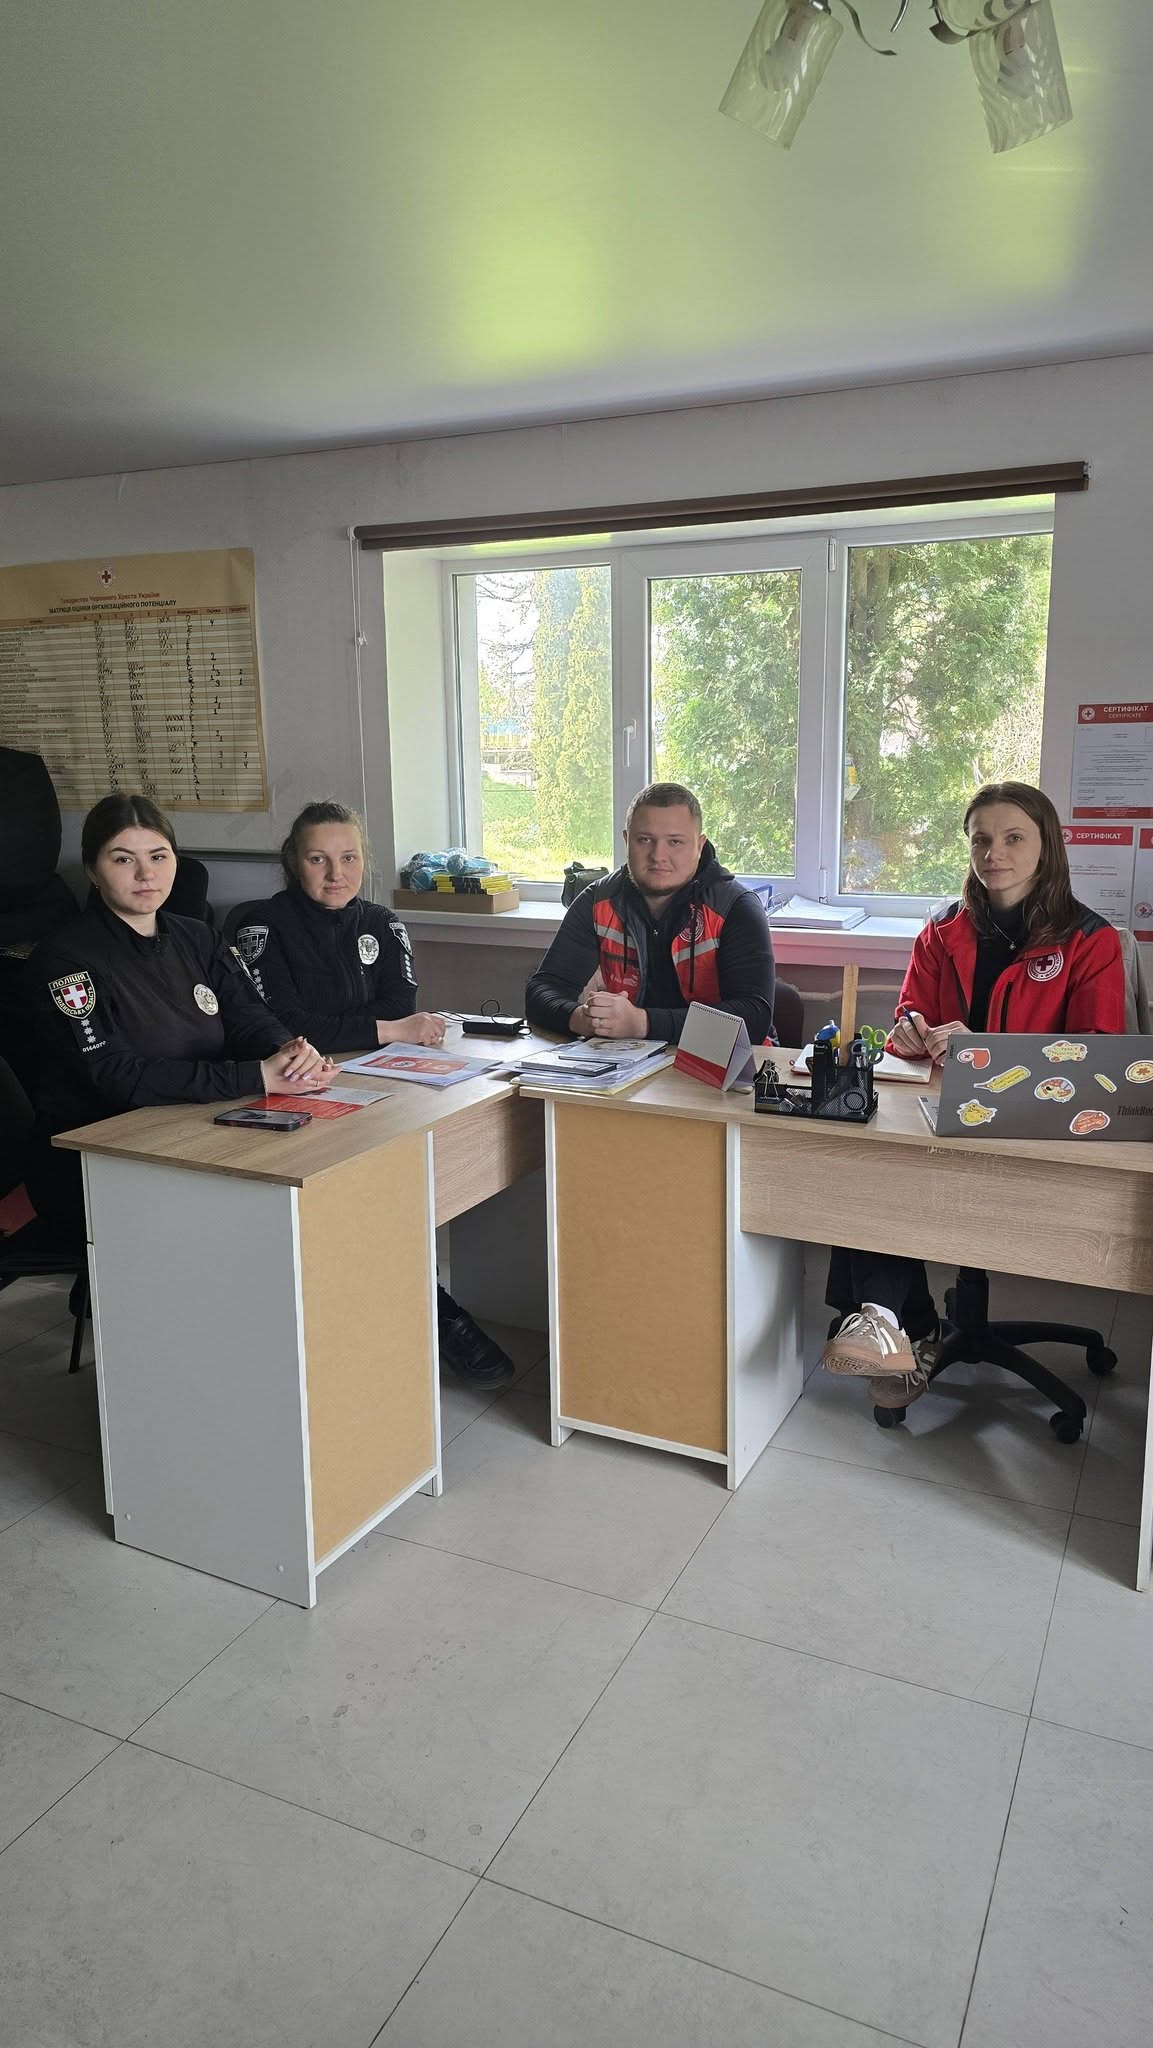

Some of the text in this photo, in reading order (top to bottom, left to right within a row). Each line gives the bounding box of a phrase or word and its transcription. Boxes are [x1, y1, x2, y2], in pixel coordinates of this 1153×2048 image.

[118, 593, 137, 601] Хреста
[49, 606, 71, 614] МАТРИЦЯ
[91, 602, 140, 610] ОРГАНІЗАЦІЙНОГО
[1103, 705, 1149, 713] СЕРТИФІКАТ
[1076, 832, 1122, 840] СЕРТИФІКАТ
[52, 973, 86, 989] ПОЛІЦІЯ
[55, 986, 94, 1015] ВОЛИНСЬКА ОБЛАСТЬ
